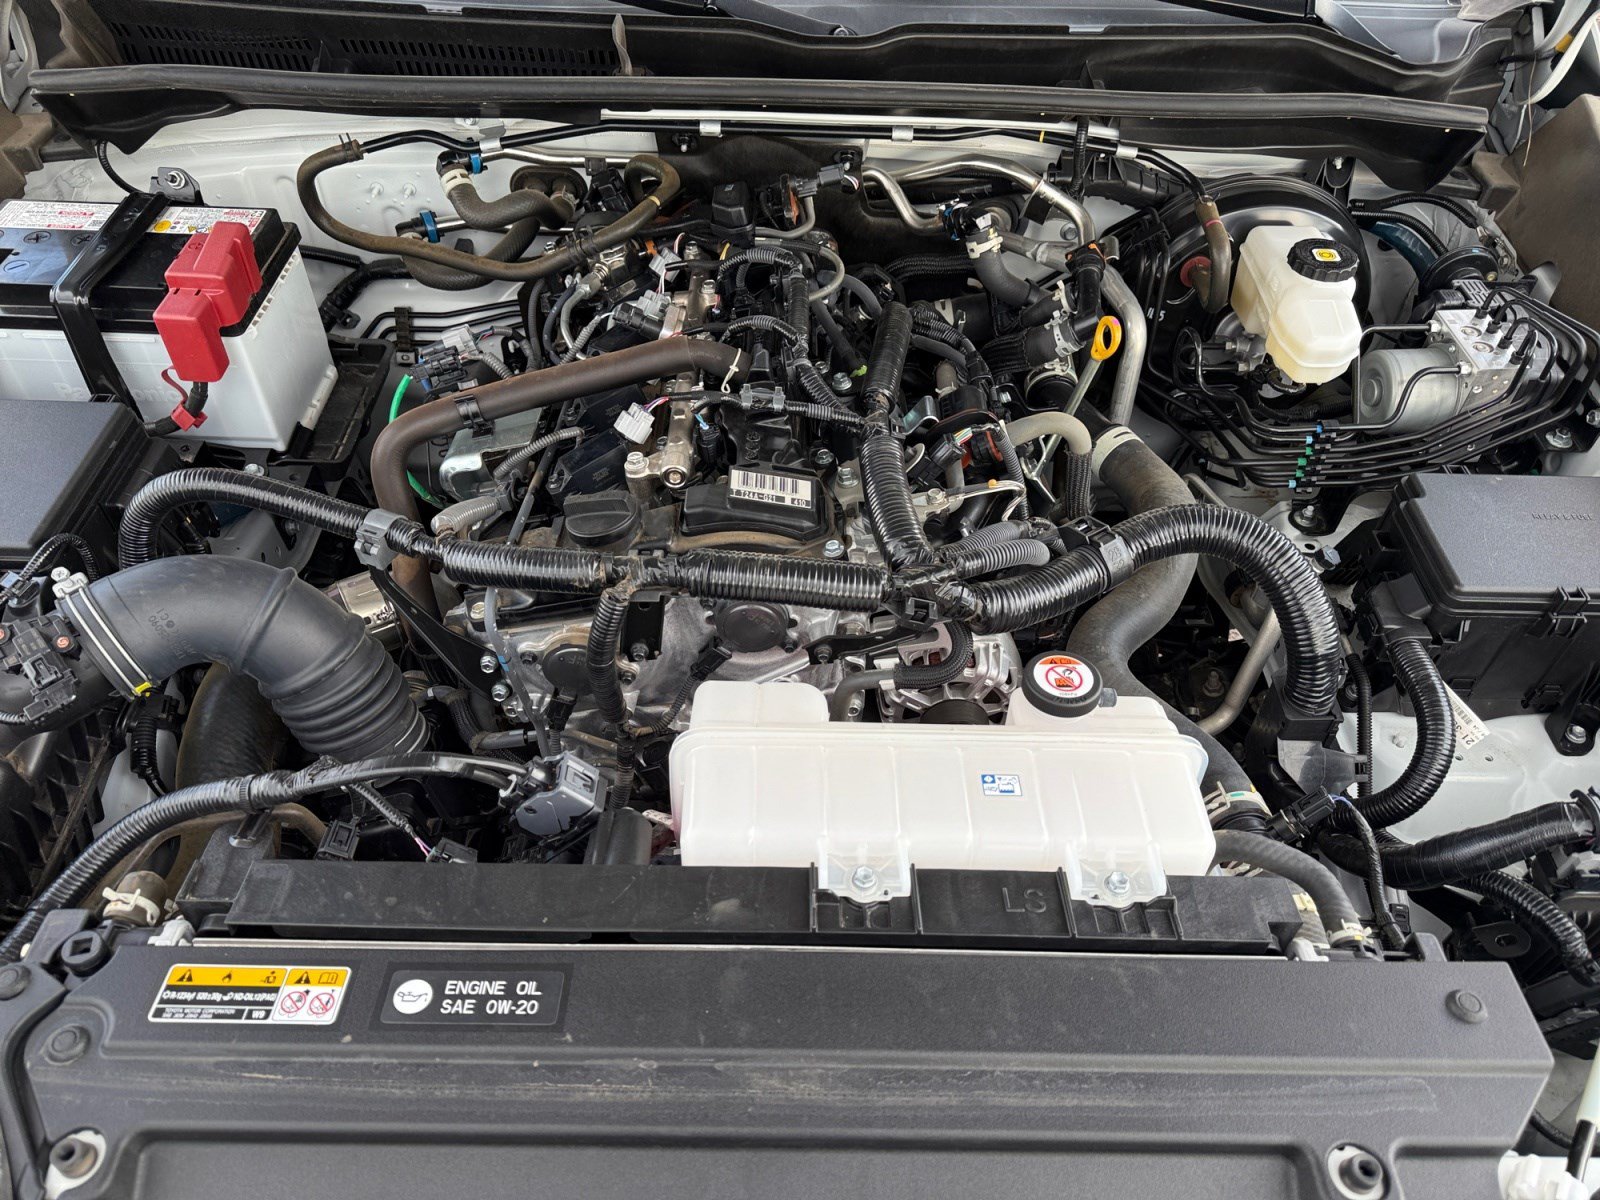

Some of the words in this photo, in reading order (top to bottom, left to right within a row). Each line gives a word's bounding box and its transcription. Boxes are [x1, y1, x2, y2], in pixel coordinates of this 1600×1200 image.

[1001, 887, 1047, 913] LS
[444, 980, 507, 996] ENGINE
[515, 980, 543, 996] OIL
[251, 1010, 266, 1019] W9
[439, 999, 476, 1015] SAE
[485, 999, 539, 1015] 0W-20
